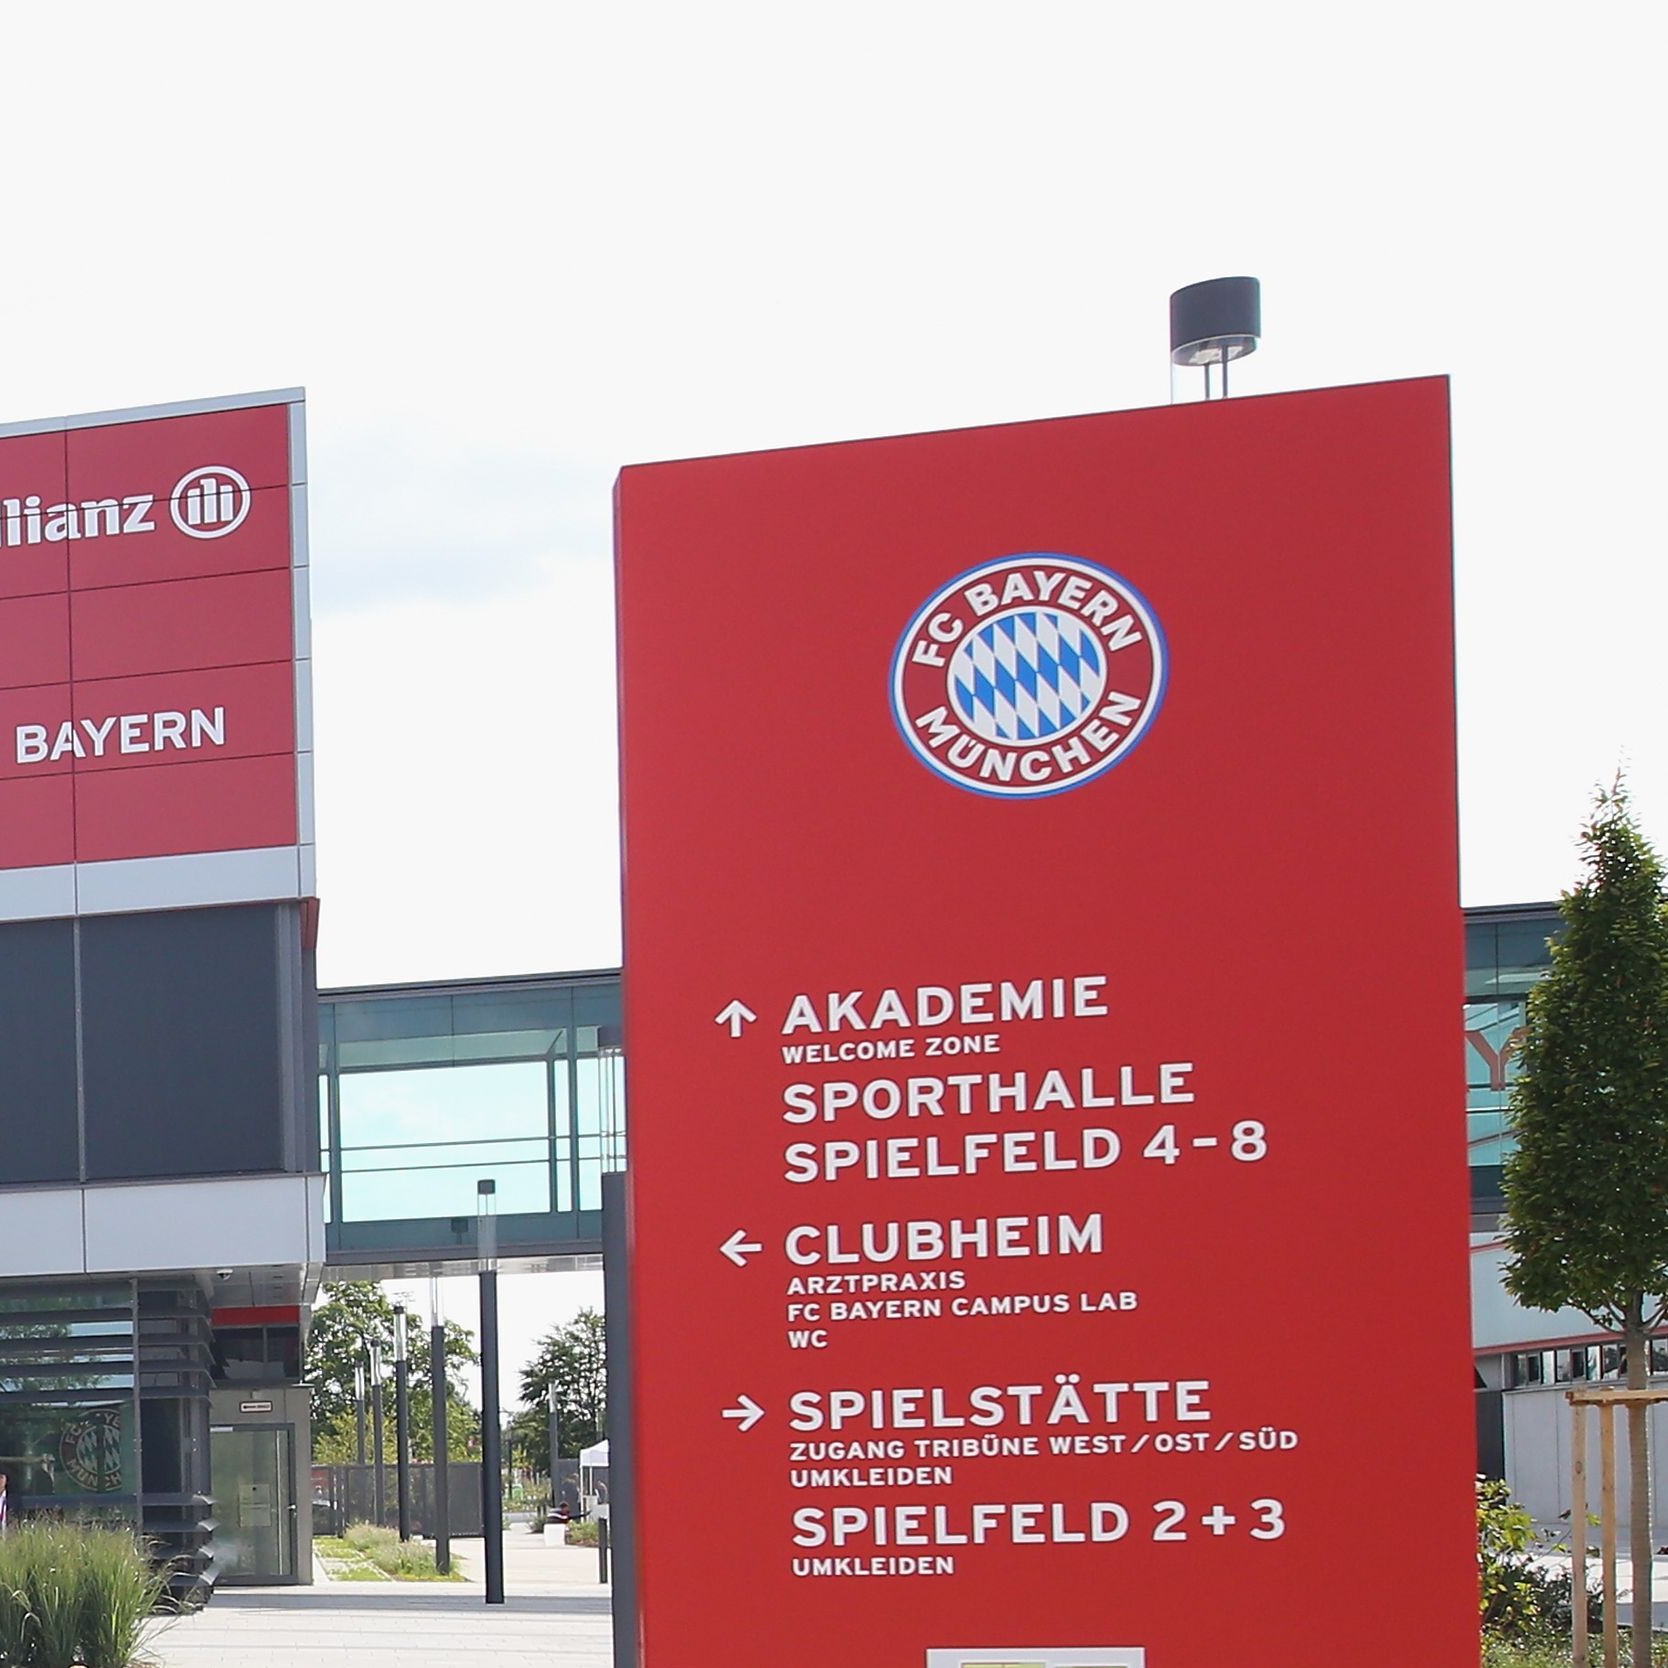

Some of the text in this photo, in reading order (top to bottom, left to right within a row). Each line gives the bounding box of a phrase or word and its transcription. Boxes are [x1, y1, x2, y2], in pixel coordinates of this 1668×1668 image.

[912, 570, 1142, 667] FC BAYERN
[16, 706, 225, 764] BAYERN
[915, 690, 1143, 782] MÜNCHEN
[782, 975, 1108, 1034] AKADEMIE
[783, 1034, 1000, 1063] WELCOME ZONE
[783, 1063, 1194, 1124] SPORTHALLE
[784, 1128, 1121, 1183] SPIELFELD
[785, 1213, 1103, 1265] CLUBHEIM
[787, 1271, 965, 1295] ARZTPRAXIS
[788, 1292, 1137, 1322] FC BAYERN CAMPUS LAB
[788, 1329, 828, 1349] WC
[789, 1373, 1211, 1431] SPIELSTÄTTE
[790, 1440, 904, 1461] ZUGANG
[914, 1433, 1039, 1458] TRIBÜNE
[791, 1466, 952, 1488] UMKLEIDEN
[793, 1502, 1129, 1547] SPIELFELD
[792, 1556, 954, 1576] UMKLEIDEN
